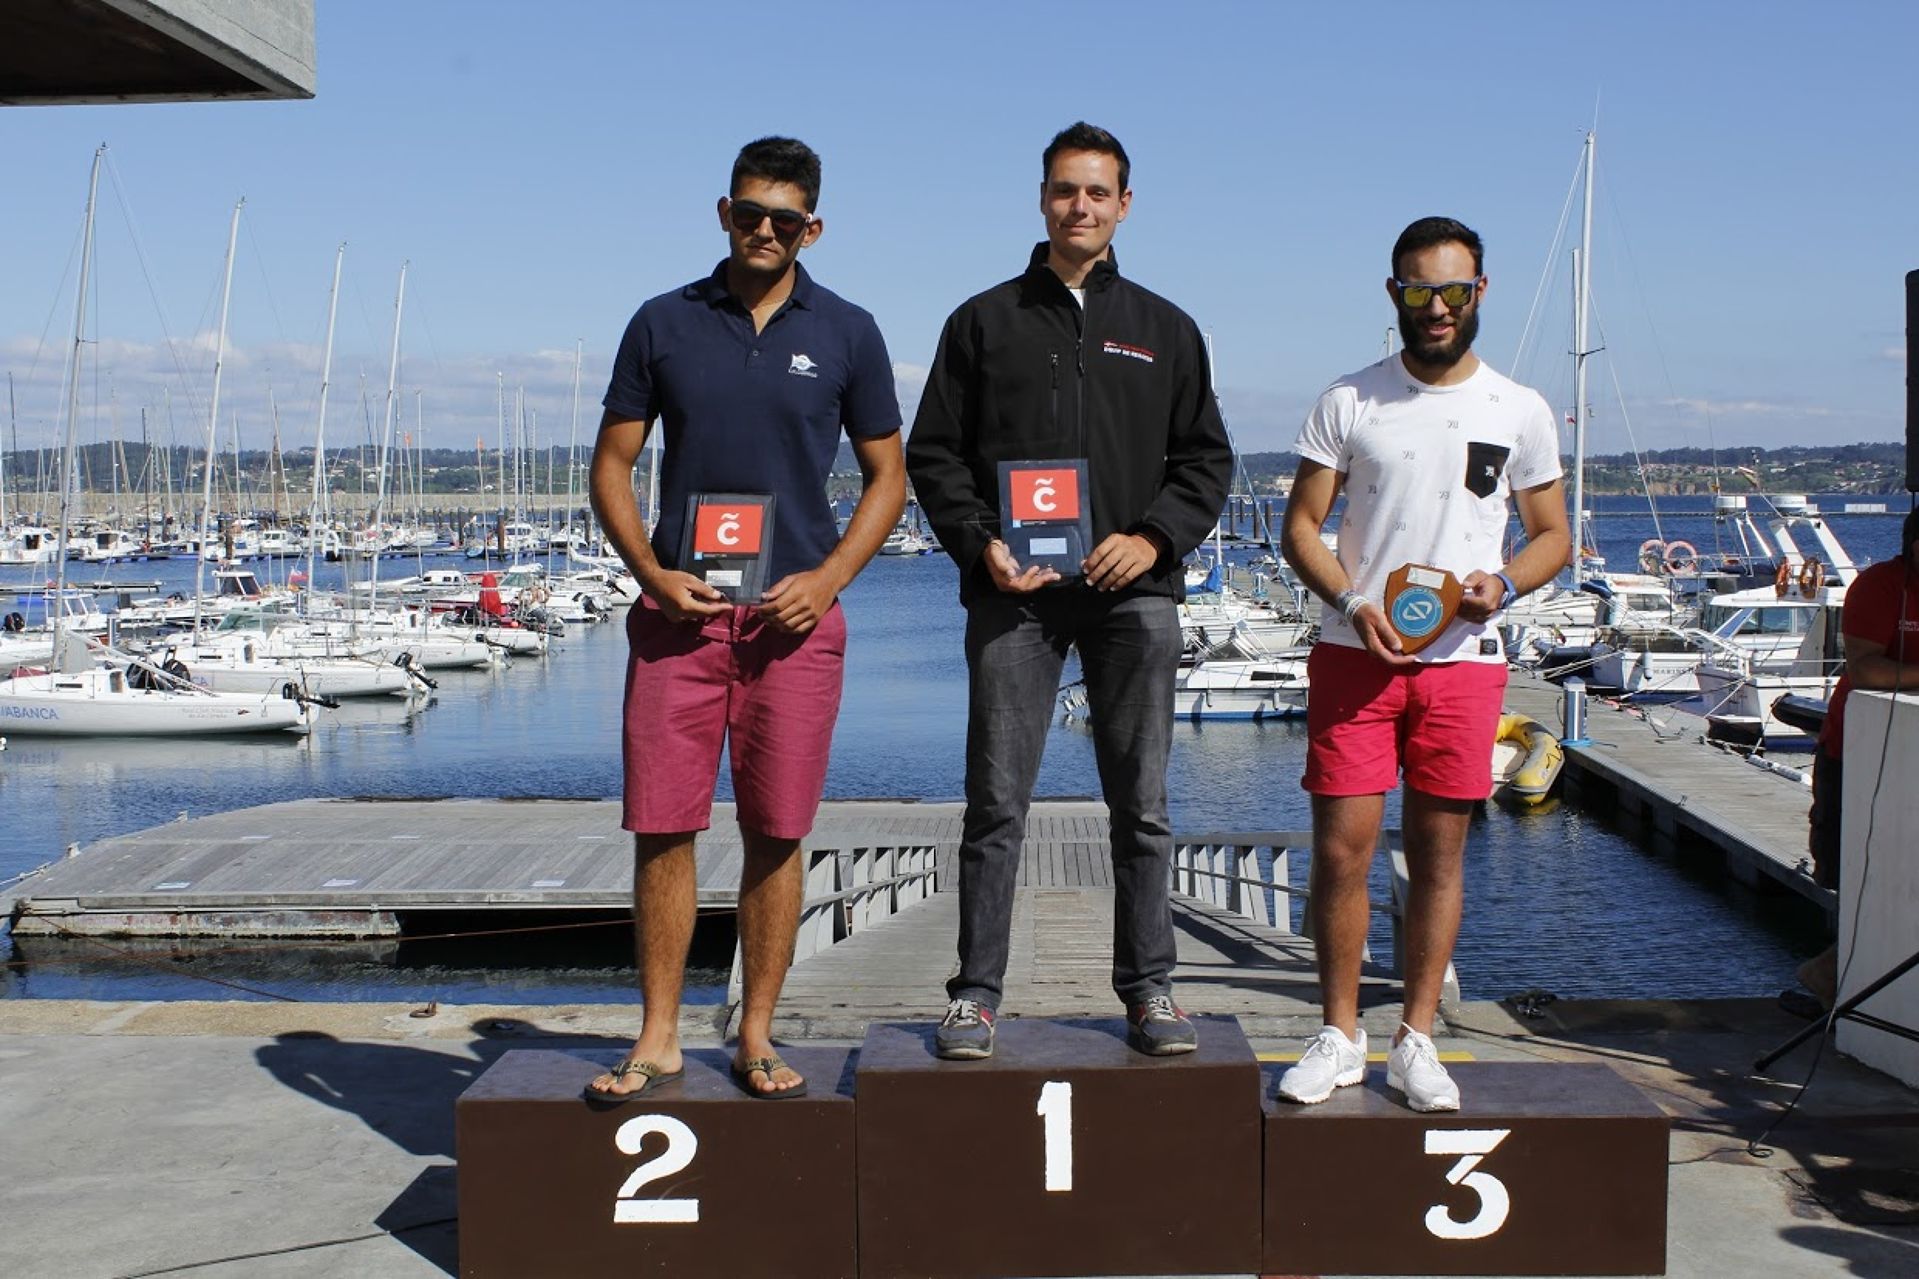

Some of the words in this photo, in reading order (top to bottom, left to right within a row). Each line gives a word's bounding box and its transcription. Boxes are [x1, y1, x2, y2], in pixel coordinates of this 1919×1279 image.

[6, 705, 60, 720] ABANCA
[613, 1114, 700, 1223] 2
[1036, 1080, 1073, 1192] 1
[1424, 1129, 1512, 1240] 3
